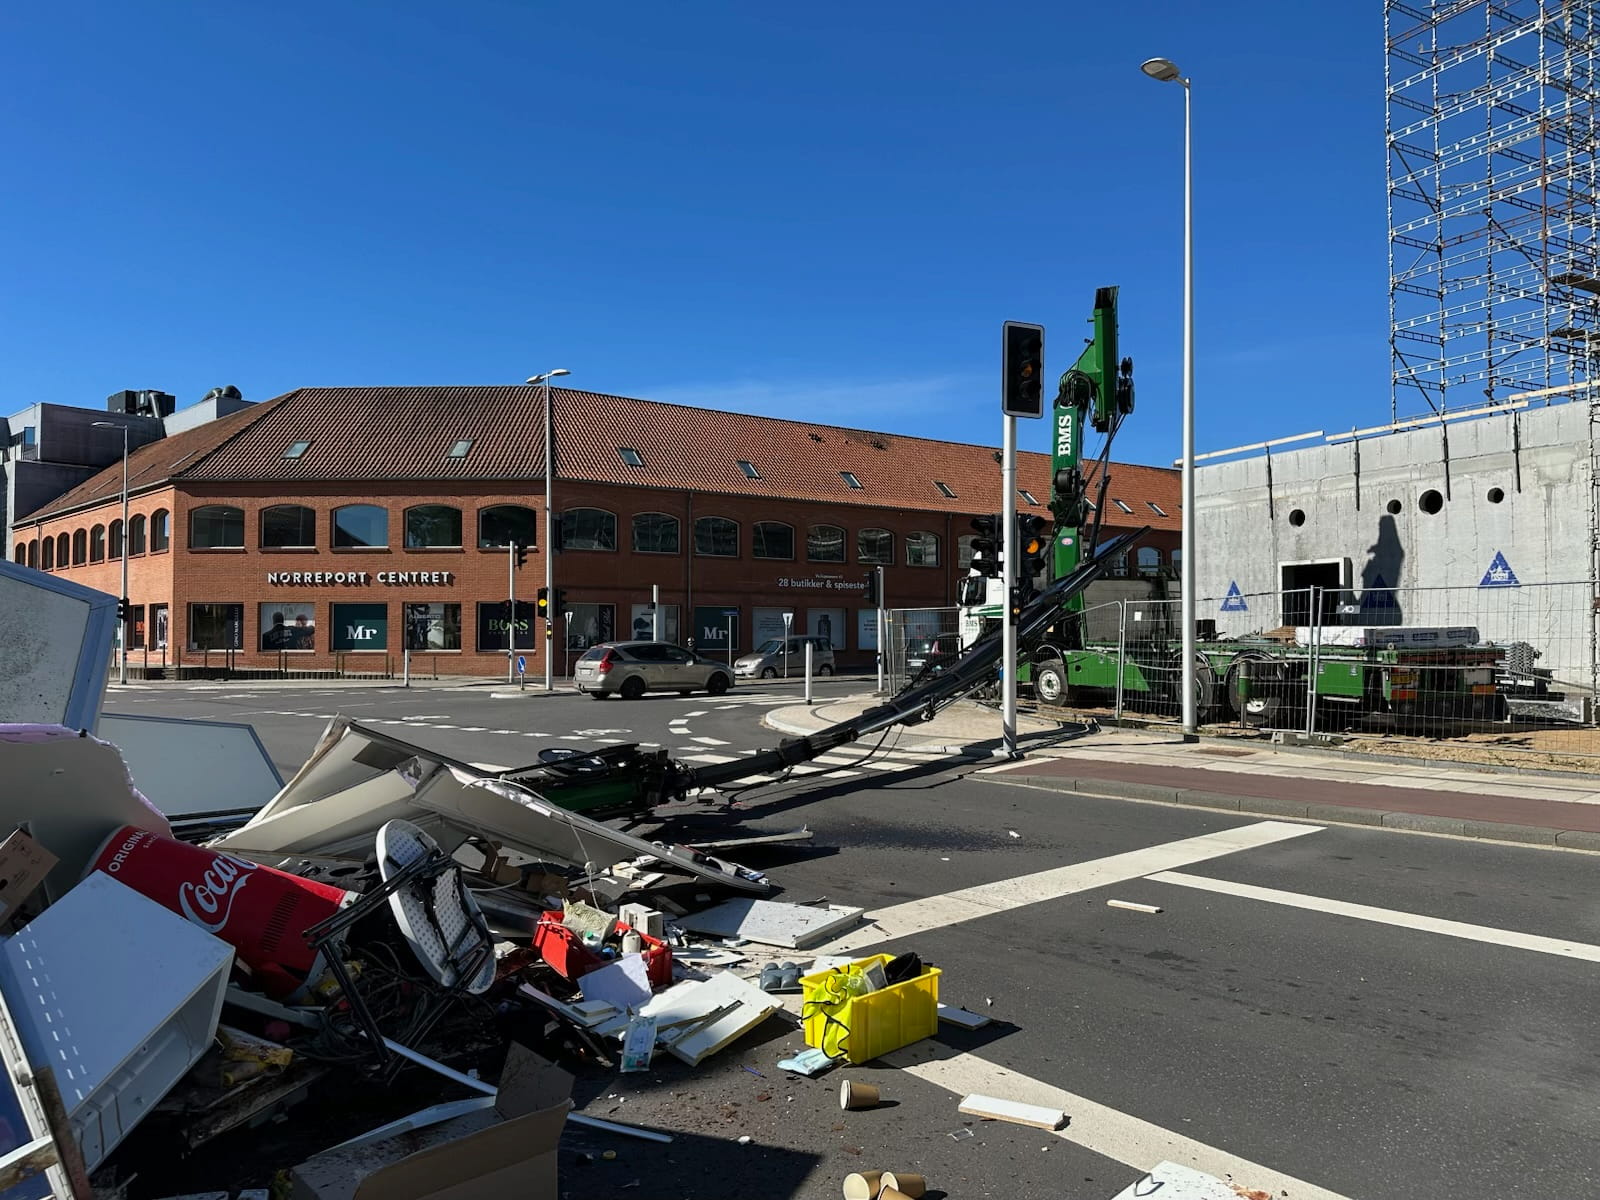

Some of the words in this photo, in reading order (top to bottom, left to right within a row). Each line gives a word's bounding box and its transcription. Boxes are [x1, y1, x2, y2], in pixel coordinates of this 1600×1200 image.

[1058, 414, 1072, 457] BMS
[376, 571, 450, 584] CENTRET
[778, 578, 789, 587] 28
[790, 578, 824, 589] butikker
[825, 579, 833, 589] &
[834, 580, 869, 591] spiseste
[346, 625, 378, 640] Mr
[703, 626, 729, 640] Mr
[108, 830, 149, 873] ORIGINA
